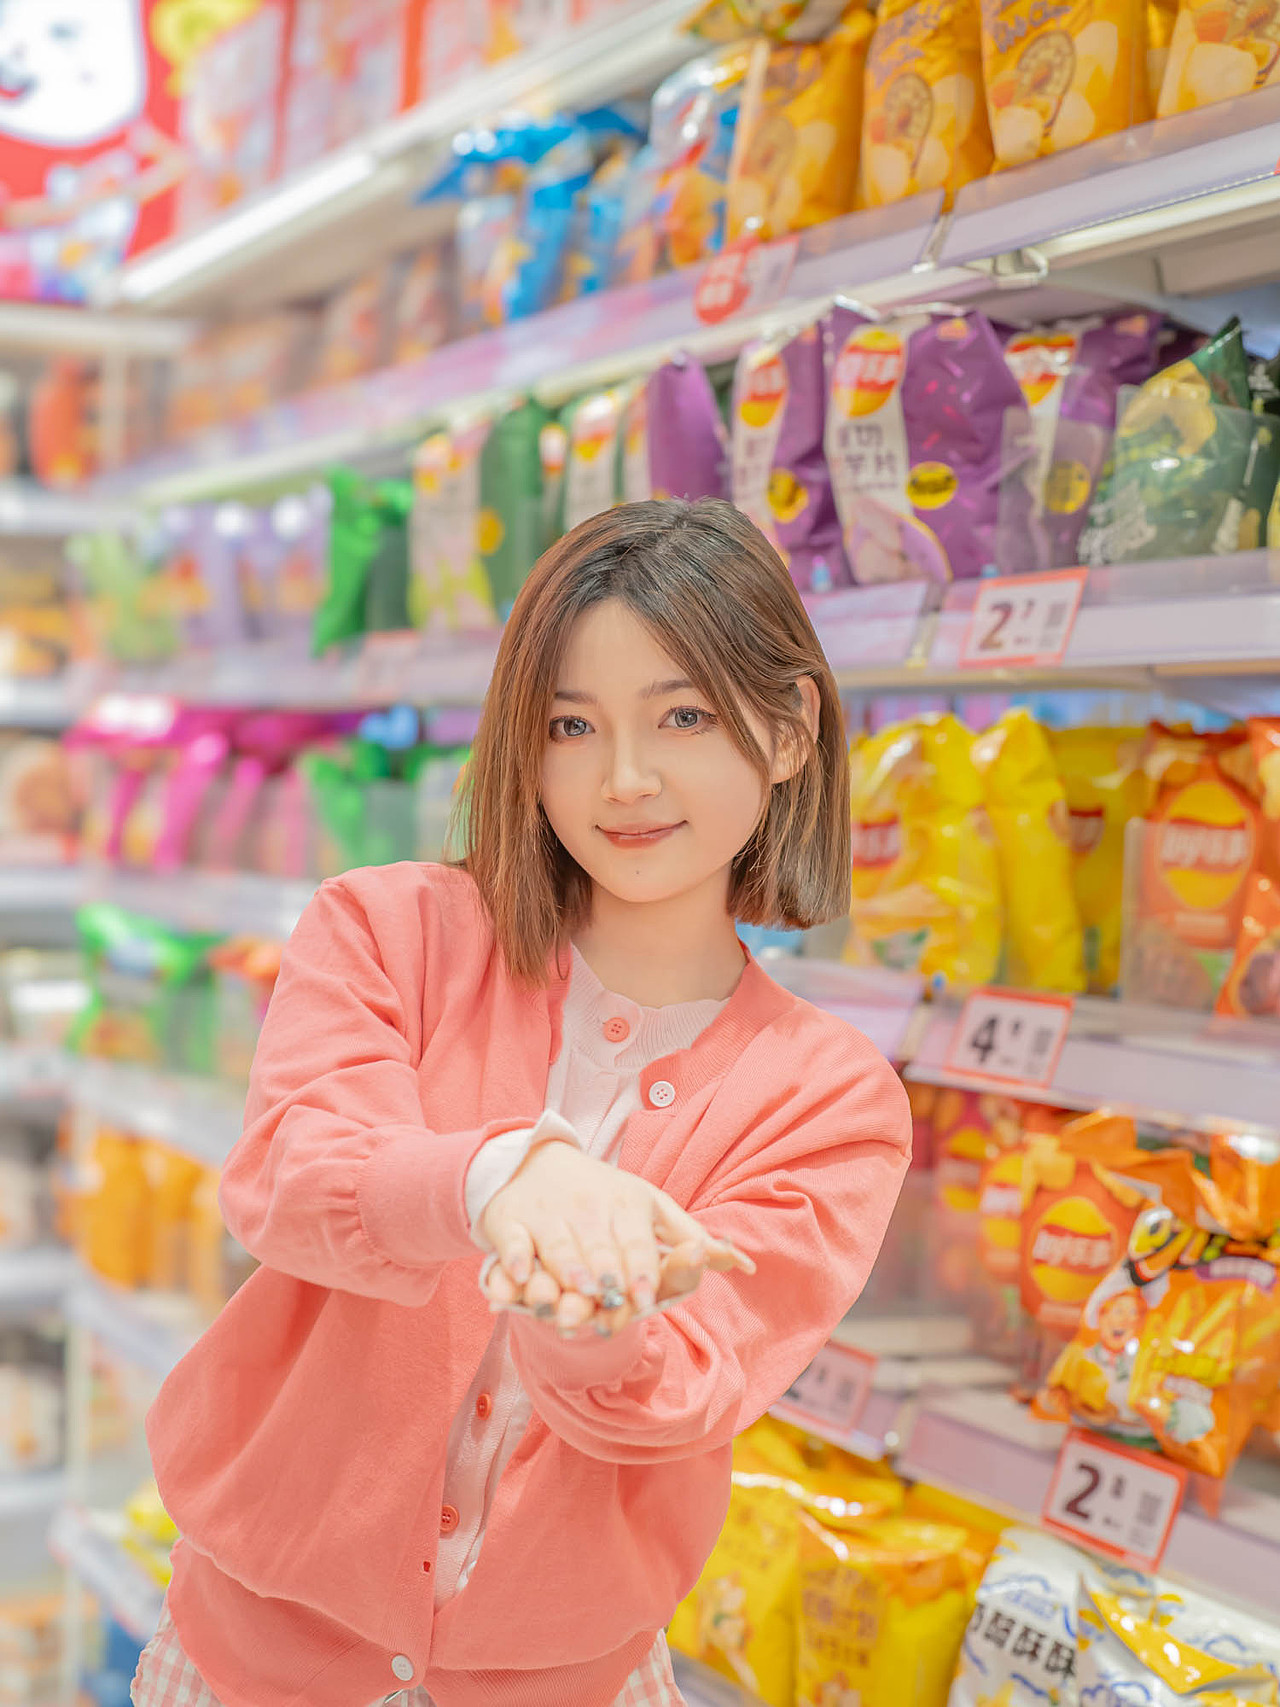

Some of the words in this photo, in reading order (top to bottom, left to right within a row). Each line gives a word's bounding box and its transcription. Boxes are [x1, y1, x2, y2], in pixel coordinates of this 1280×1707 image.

[980, 602, 1013, 651] 2
[970, 1016, 998, 1064] 4
[1063, 1462, 1100, 1520] 2
